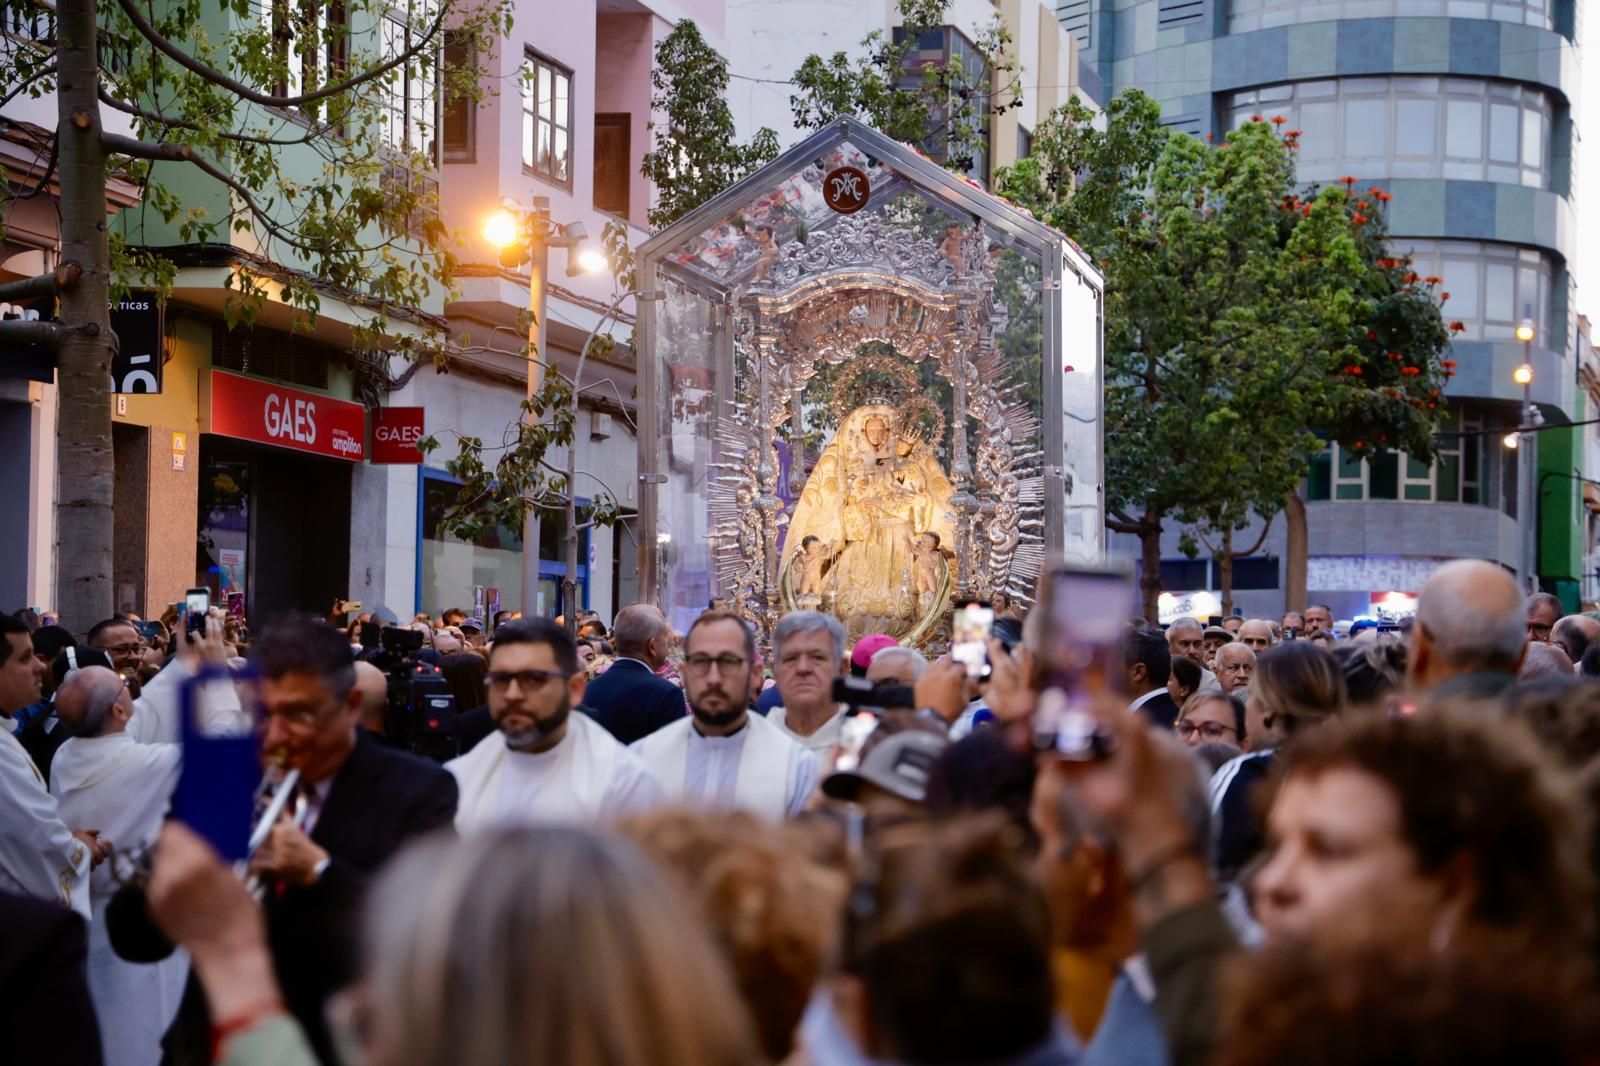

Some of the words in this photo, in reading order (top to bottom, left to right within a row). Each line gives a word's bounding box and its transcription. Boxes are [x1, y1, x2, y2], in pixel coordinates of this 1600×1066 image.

[264, 393, 316, 445] GAES
[375, 426, 421, 442] GAES
[332, 436, 362, 456] amplifon
